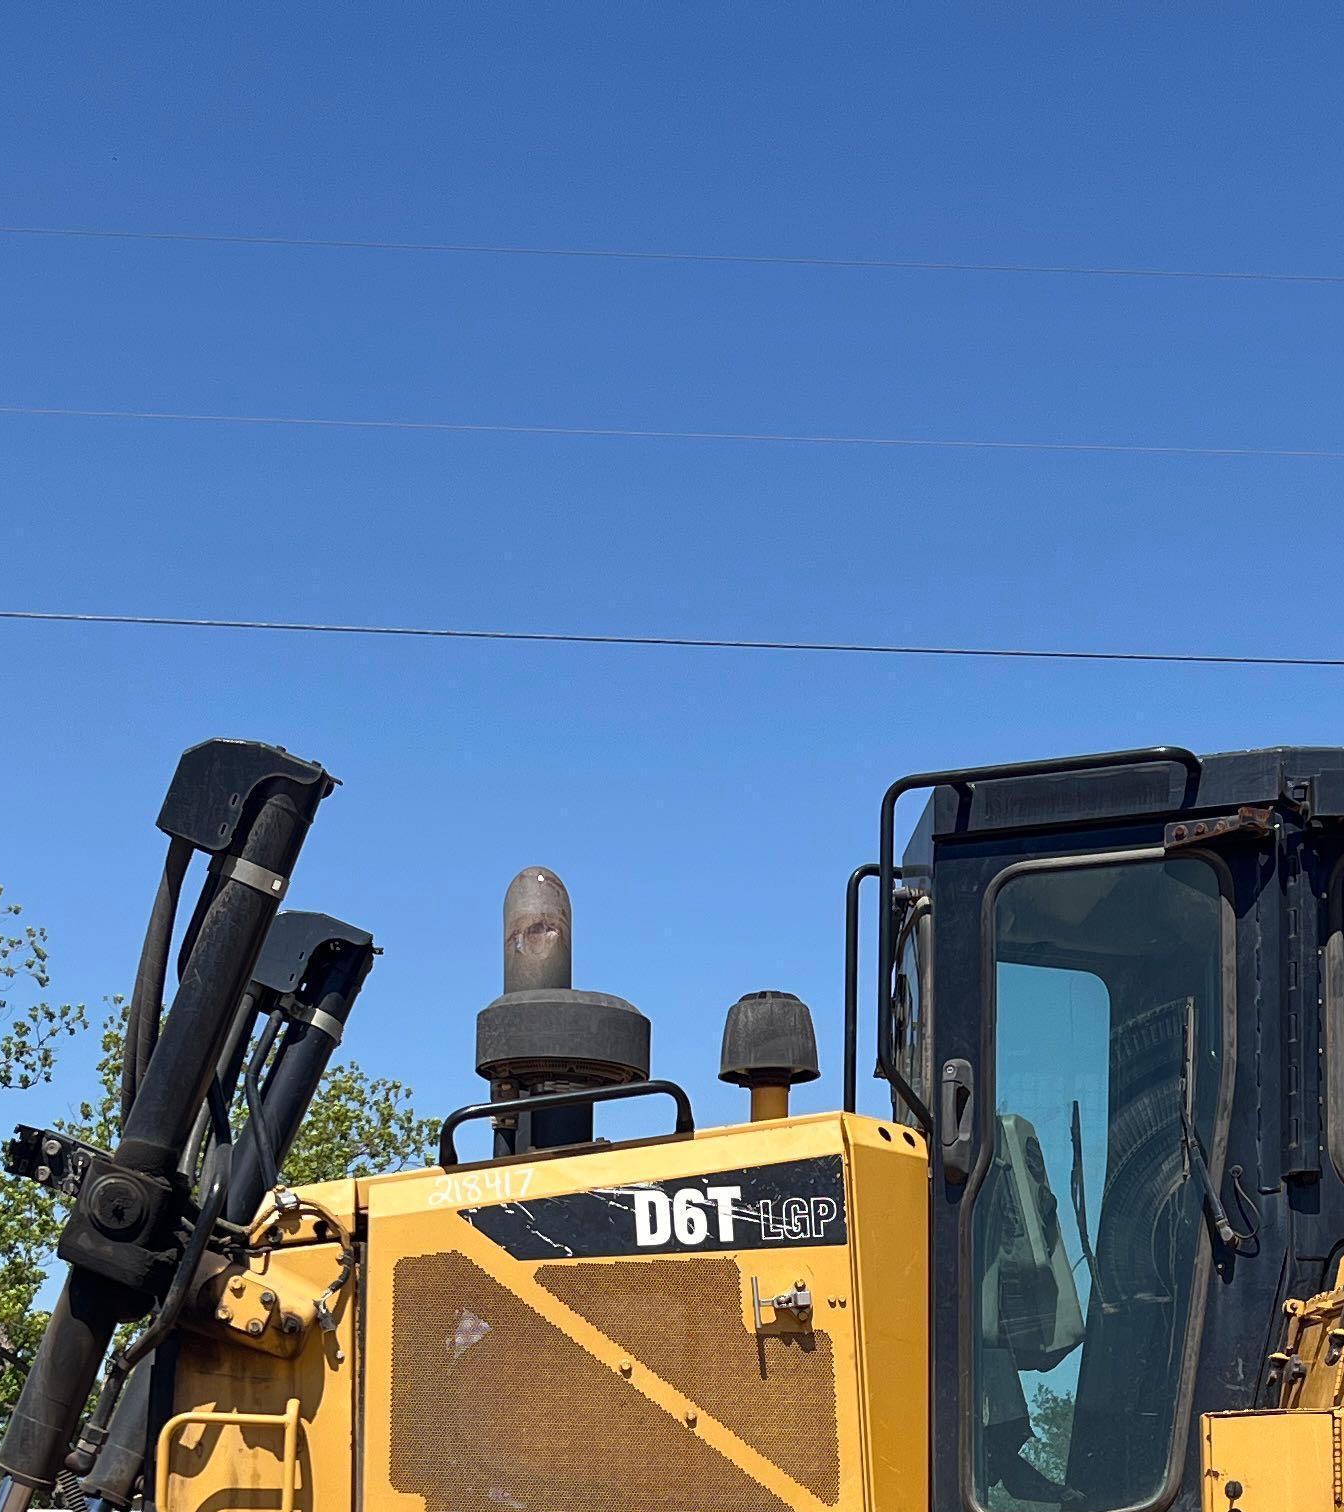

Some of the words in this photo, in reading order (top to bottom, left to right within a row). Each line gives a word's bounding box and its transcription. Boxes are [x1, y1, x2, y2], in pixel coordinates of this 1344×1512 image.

[428, 1168, 535, 1206] 218417
[634, 1186, 741, 1246] D6T
[760, 1197, 837, 1240] LGP
